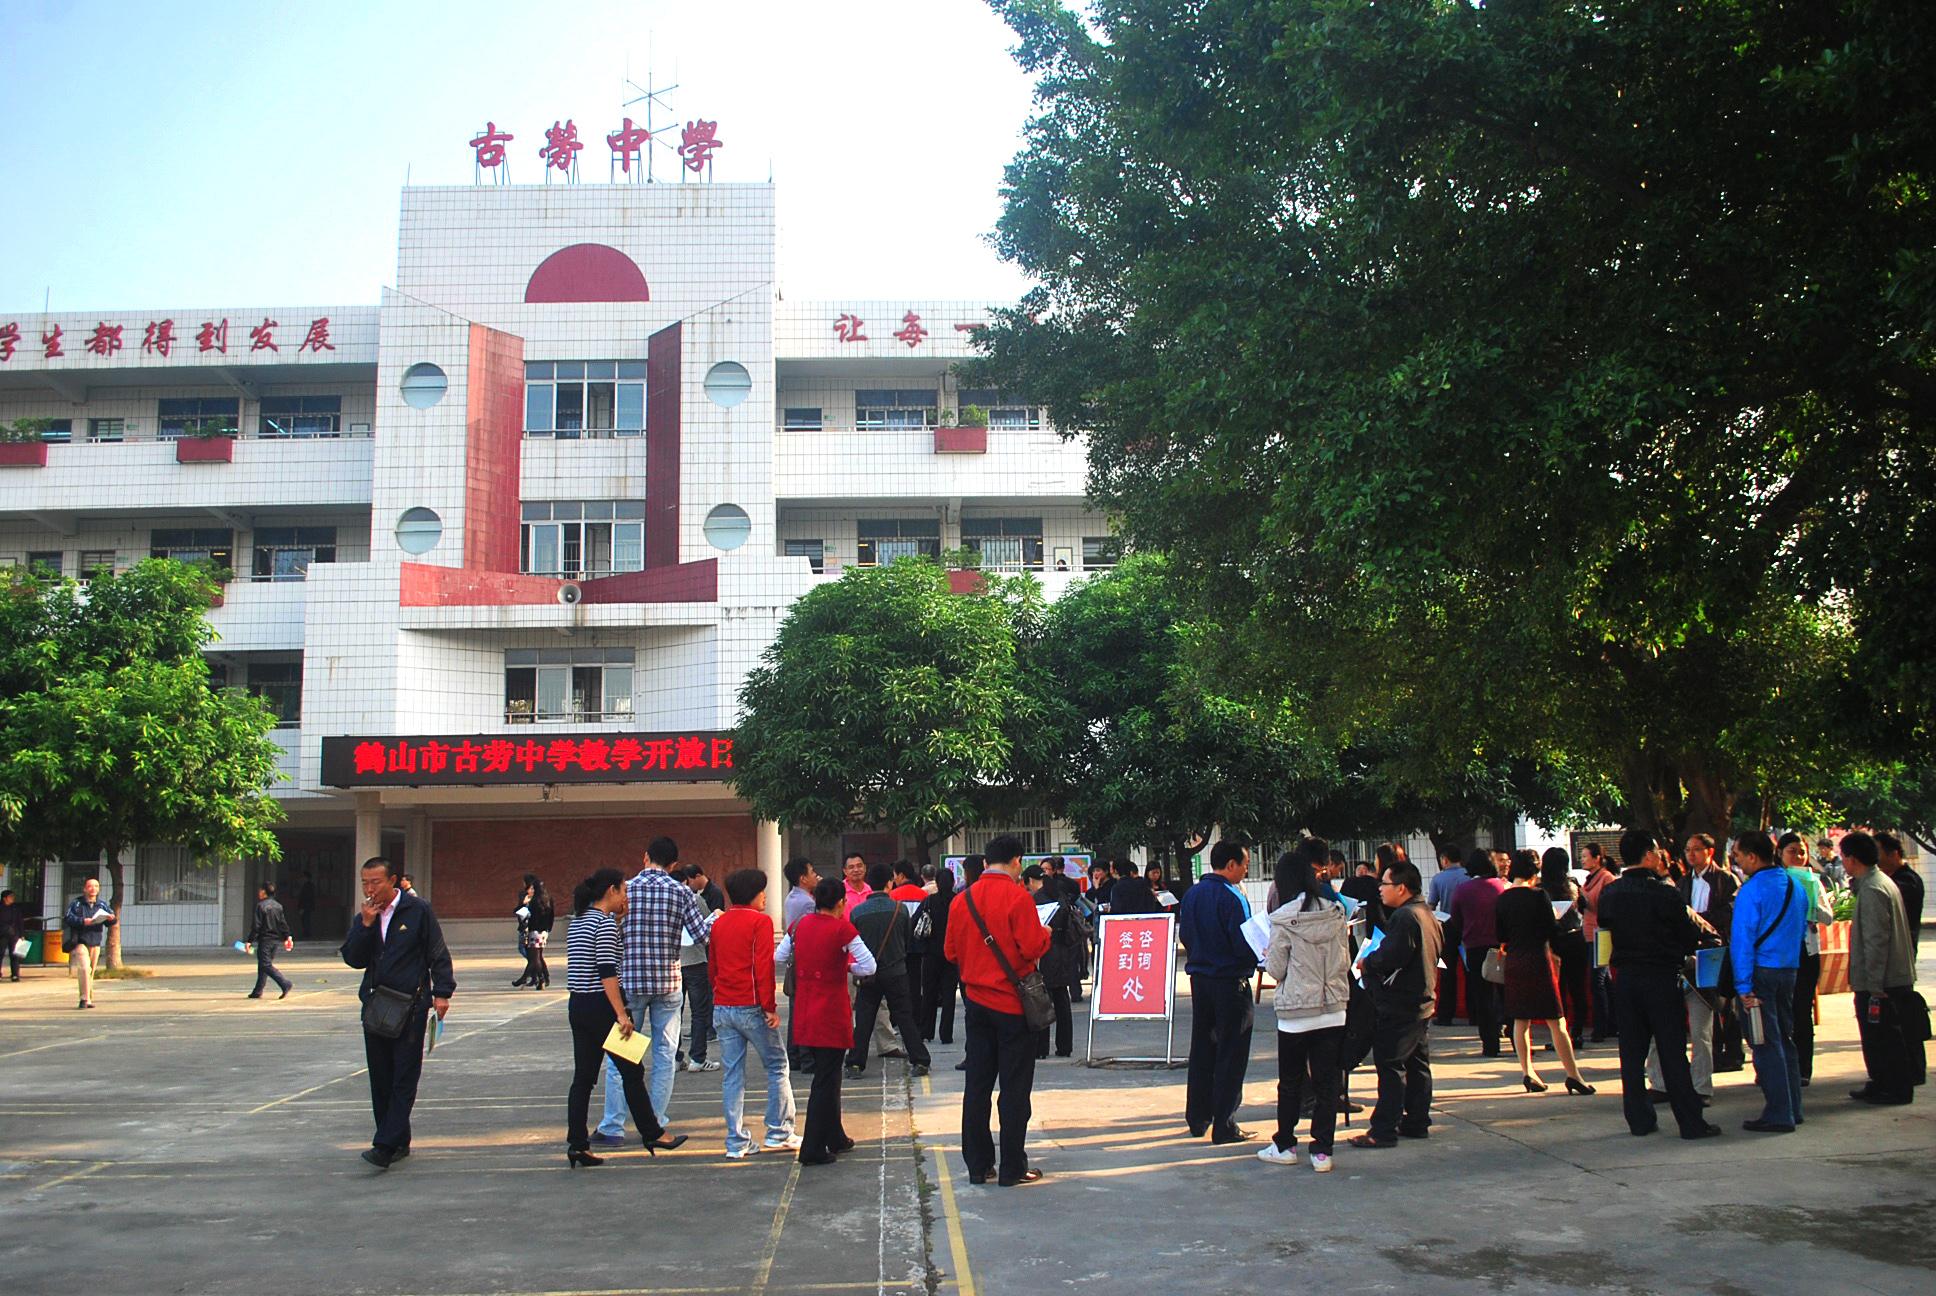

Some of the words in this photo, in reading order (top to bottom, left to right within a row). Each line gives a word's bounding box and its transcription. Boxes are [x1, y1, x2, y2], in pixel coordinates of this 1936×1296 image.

[833, 310, 1039, 348] 让每一
[1122, 975, 1145, 1002] 处
